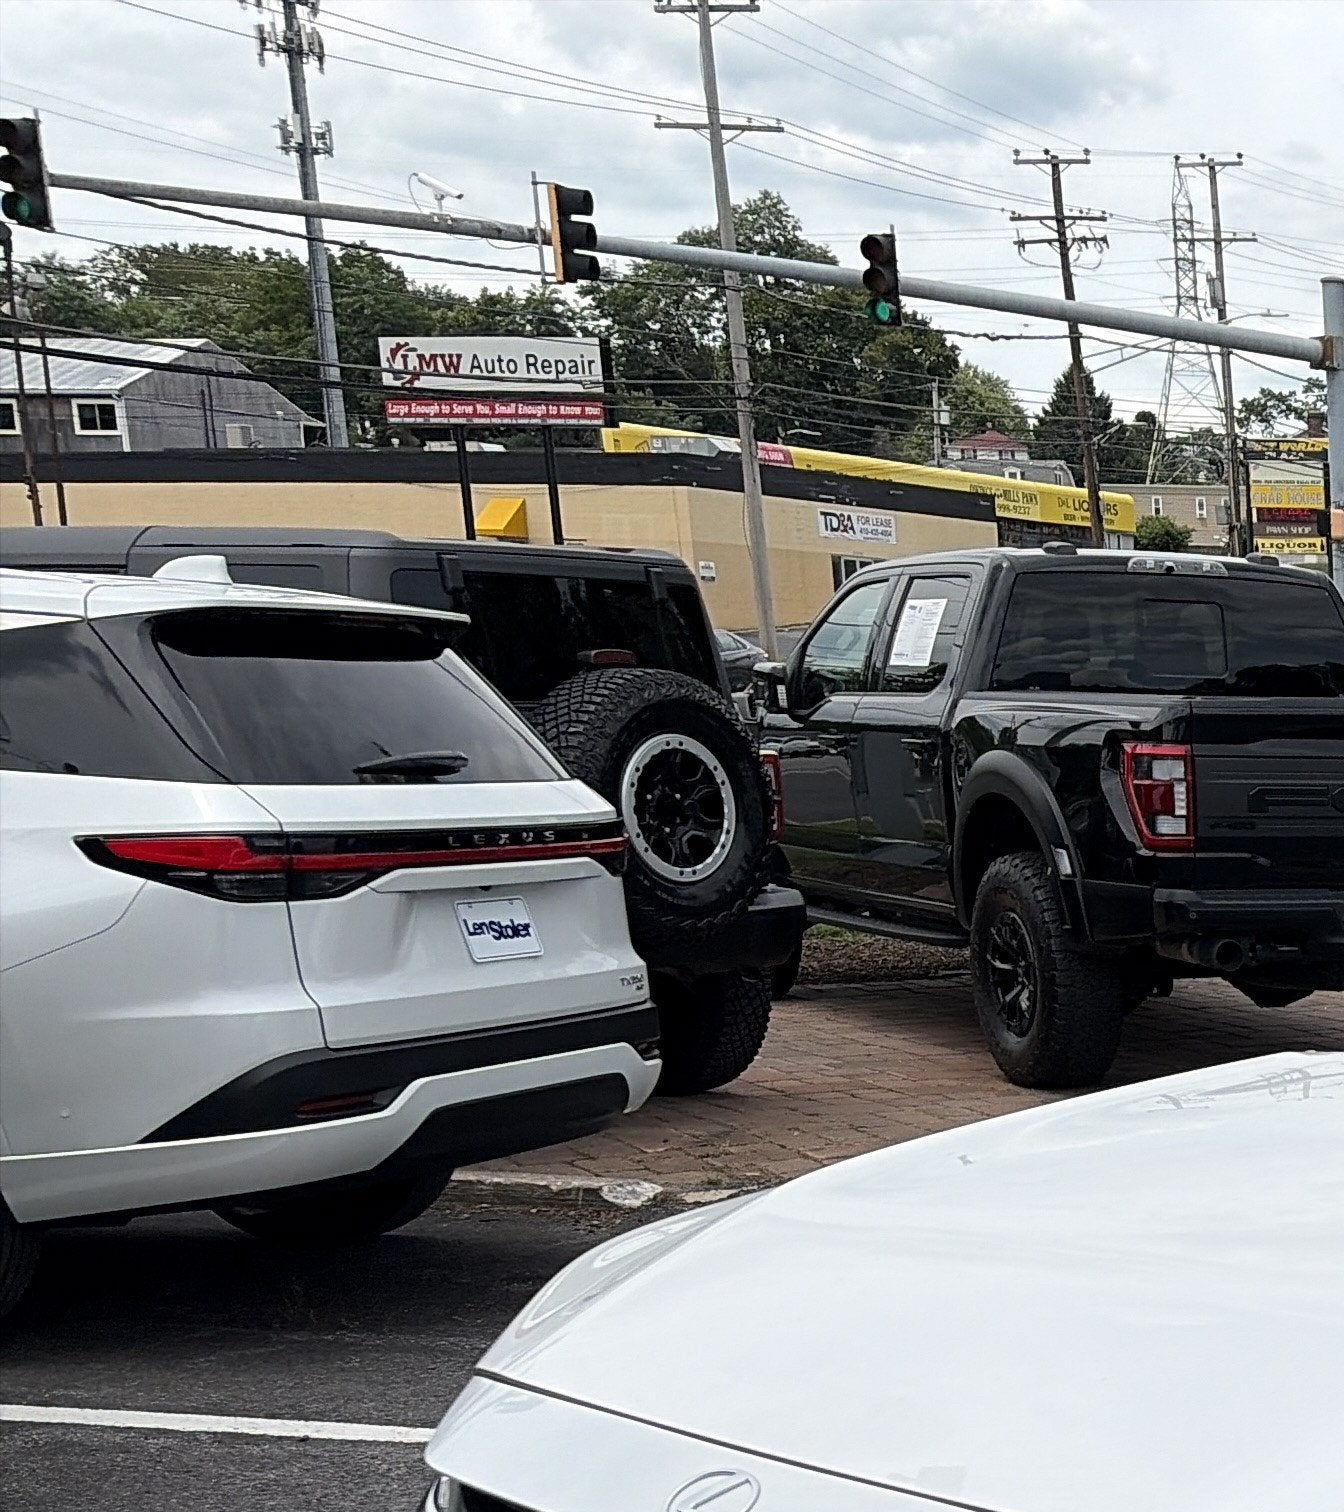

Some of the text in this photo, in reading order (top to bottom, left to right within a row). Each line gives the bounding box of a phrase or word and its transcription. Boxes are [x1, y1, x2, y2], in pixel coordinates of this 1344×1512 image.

[469, 354, 518, 374] Auto
[525, 354, 595, 380] Repair
[388, 403, 409, 416] Large
[411, 403, 440, 416] Enough
[441, 404, 450, 414] to
[452, 403, 474, 414] Serve
[476, 404, 492, 415] You,
[494, 403, 517, 414] Small
[518, 403, 547, 416] Enough
[549, 404, 558, 414] to
[819, 511, 893, 536] TD&A FOR LEASE
[1261, 542, 1318, 550] LIQUOR
[449, 830, 555, 846] LEXUS
